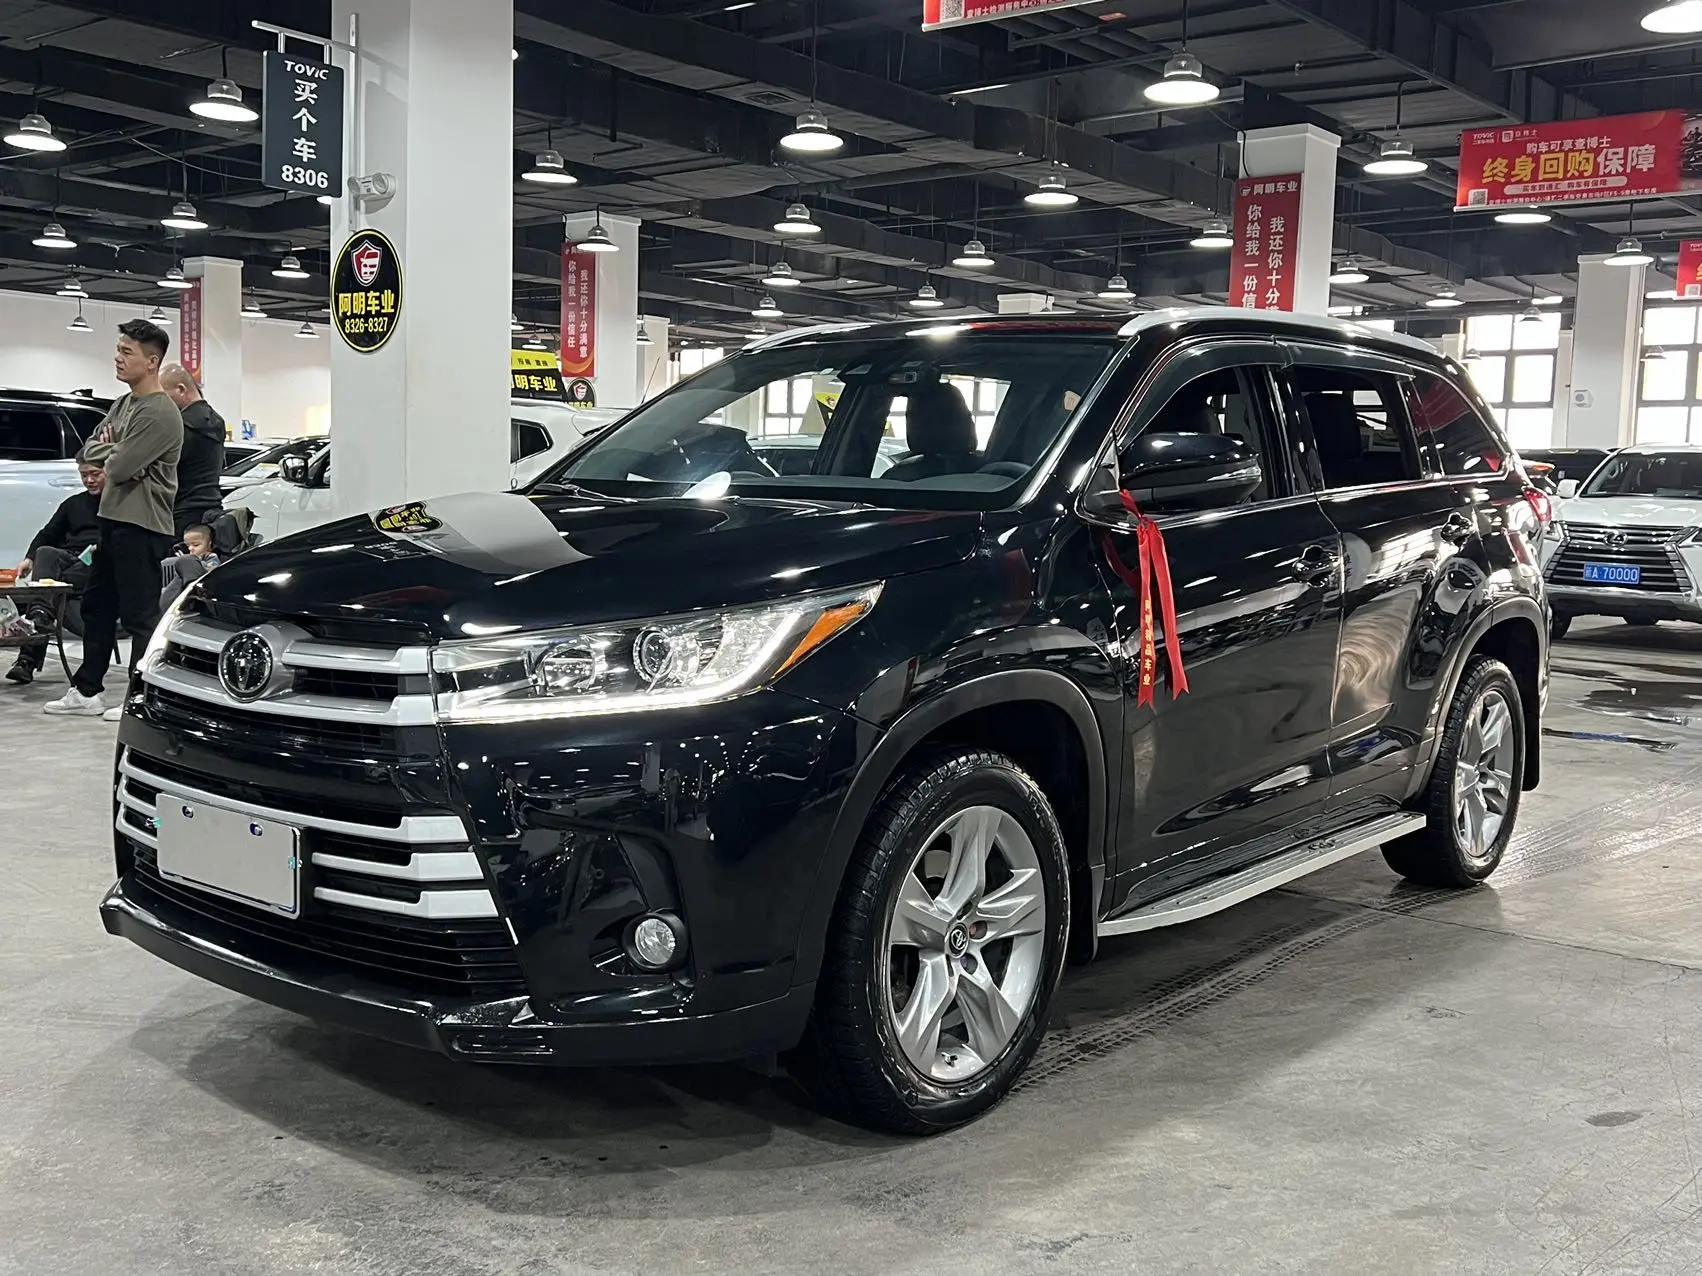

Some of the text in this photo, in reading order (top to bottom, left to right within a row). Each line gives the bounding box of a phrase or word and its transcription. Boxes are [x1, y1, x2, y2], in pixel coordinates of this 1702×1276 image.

[283, 59, 329, 80] TOVIC
[292, 79, 318, 162] 买个车
[1472, 131, 1496, 140] TOVIC
[1526, 135, 1611, 154] 购车可享查博士
[1482, 143, 1656, 184] 终身回购保障
[281, 165, 329, 189] 8306
[1253, 180, 1298, 196] 阿明车业
[1265, 216, 1285, 311] 我还你十分
[338, 289, 395, 316] 阿明车业
[567, 260, 577, 348] 你给我一份信任
[579, 269, 589, 358] 我还你十分满意
[345, 316, 389, 333] 8326-8327
[511, 374, 558, 392] 明车业
